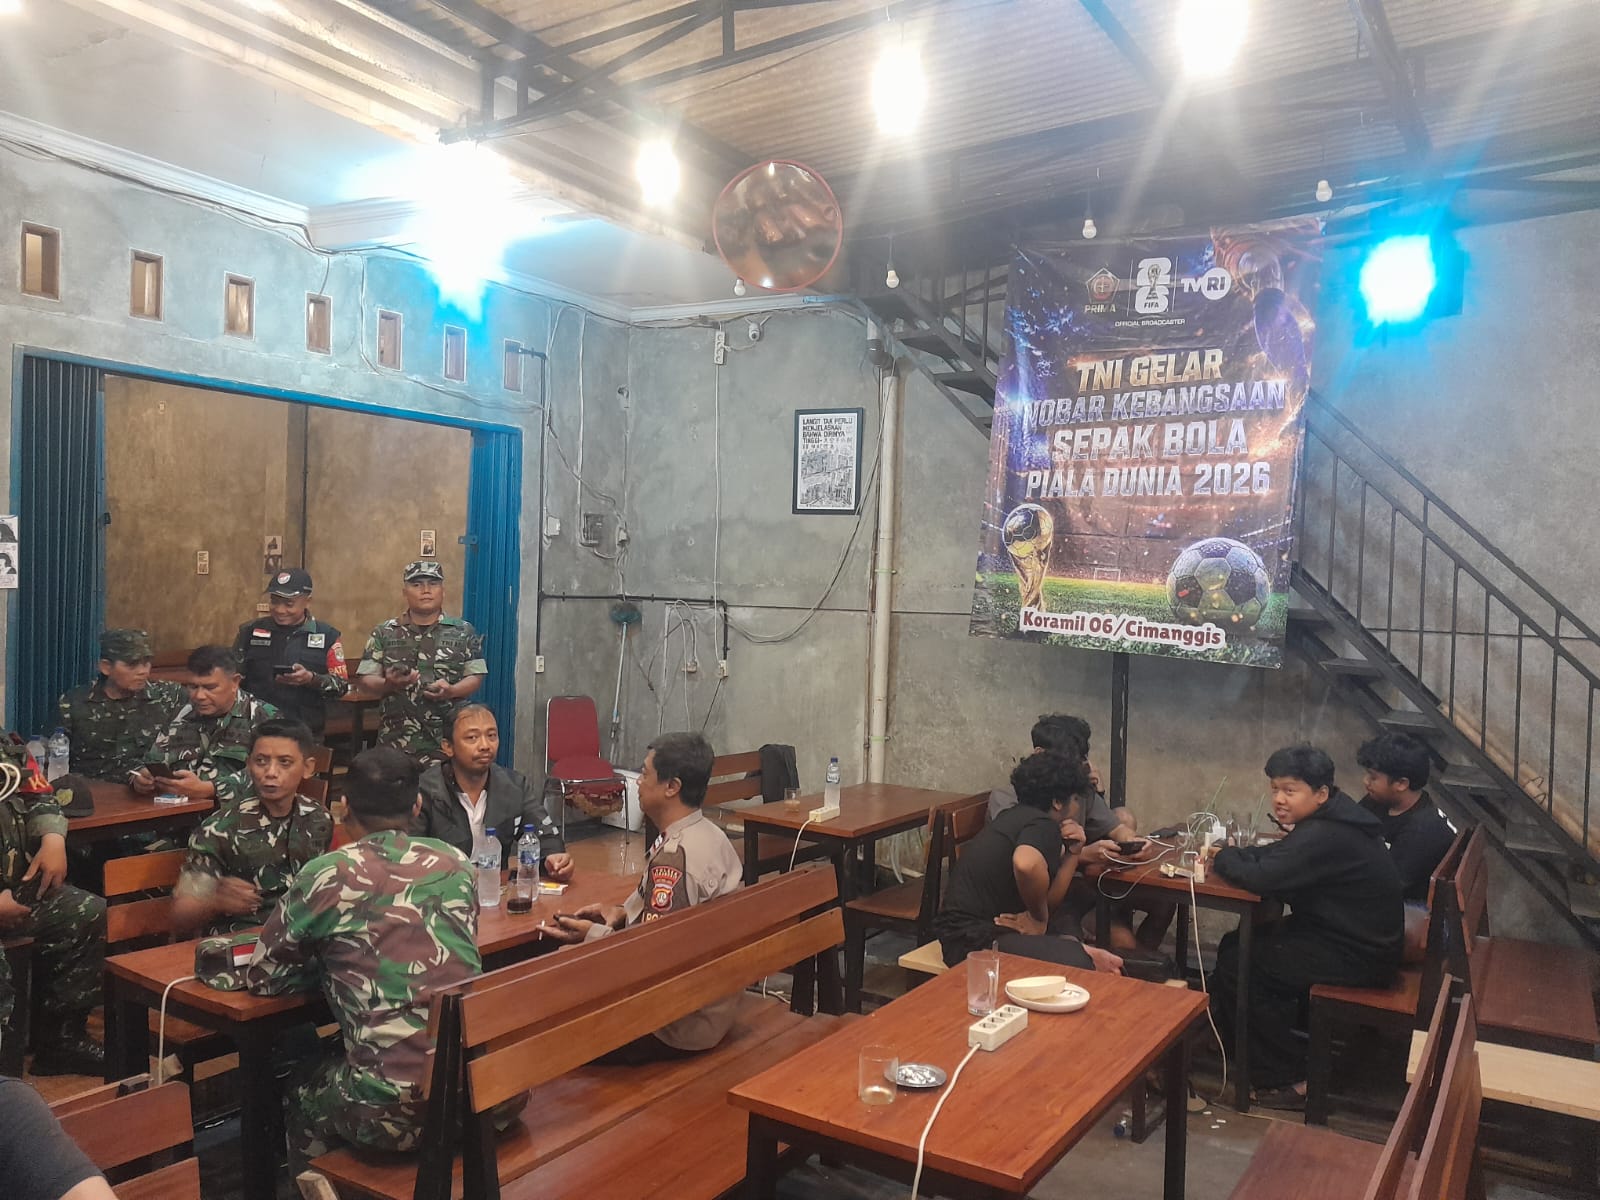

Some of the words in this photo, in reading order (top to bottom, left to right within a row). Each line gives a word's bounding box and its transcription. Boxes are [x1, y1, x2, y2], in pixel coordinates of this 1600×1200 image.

[1141, 318, 1186, 326] BROADCASTER
[1143, 301, 1160, 309] FIFA
[1076, 357, 1124, 393] TNI
[1129, 349, 1224, 387] GELAR
[1022, 395, 1106, 429] NOBAR
[1111, 379, 1288, 421] KEBANGSAAN
[1051, 424, 1158, 461] SEPAK
[1162, 418, 1249, 458] BOLA
[1025, 469, 1096, 500] PIALA
[1102, 465, 1183, 497] DUNIA
[1193, 461, 1271, 496] 2026
[1023, 611, 1085, 632] Koramil
[1089, 616, 1222, 647] 06/Cimanggis
